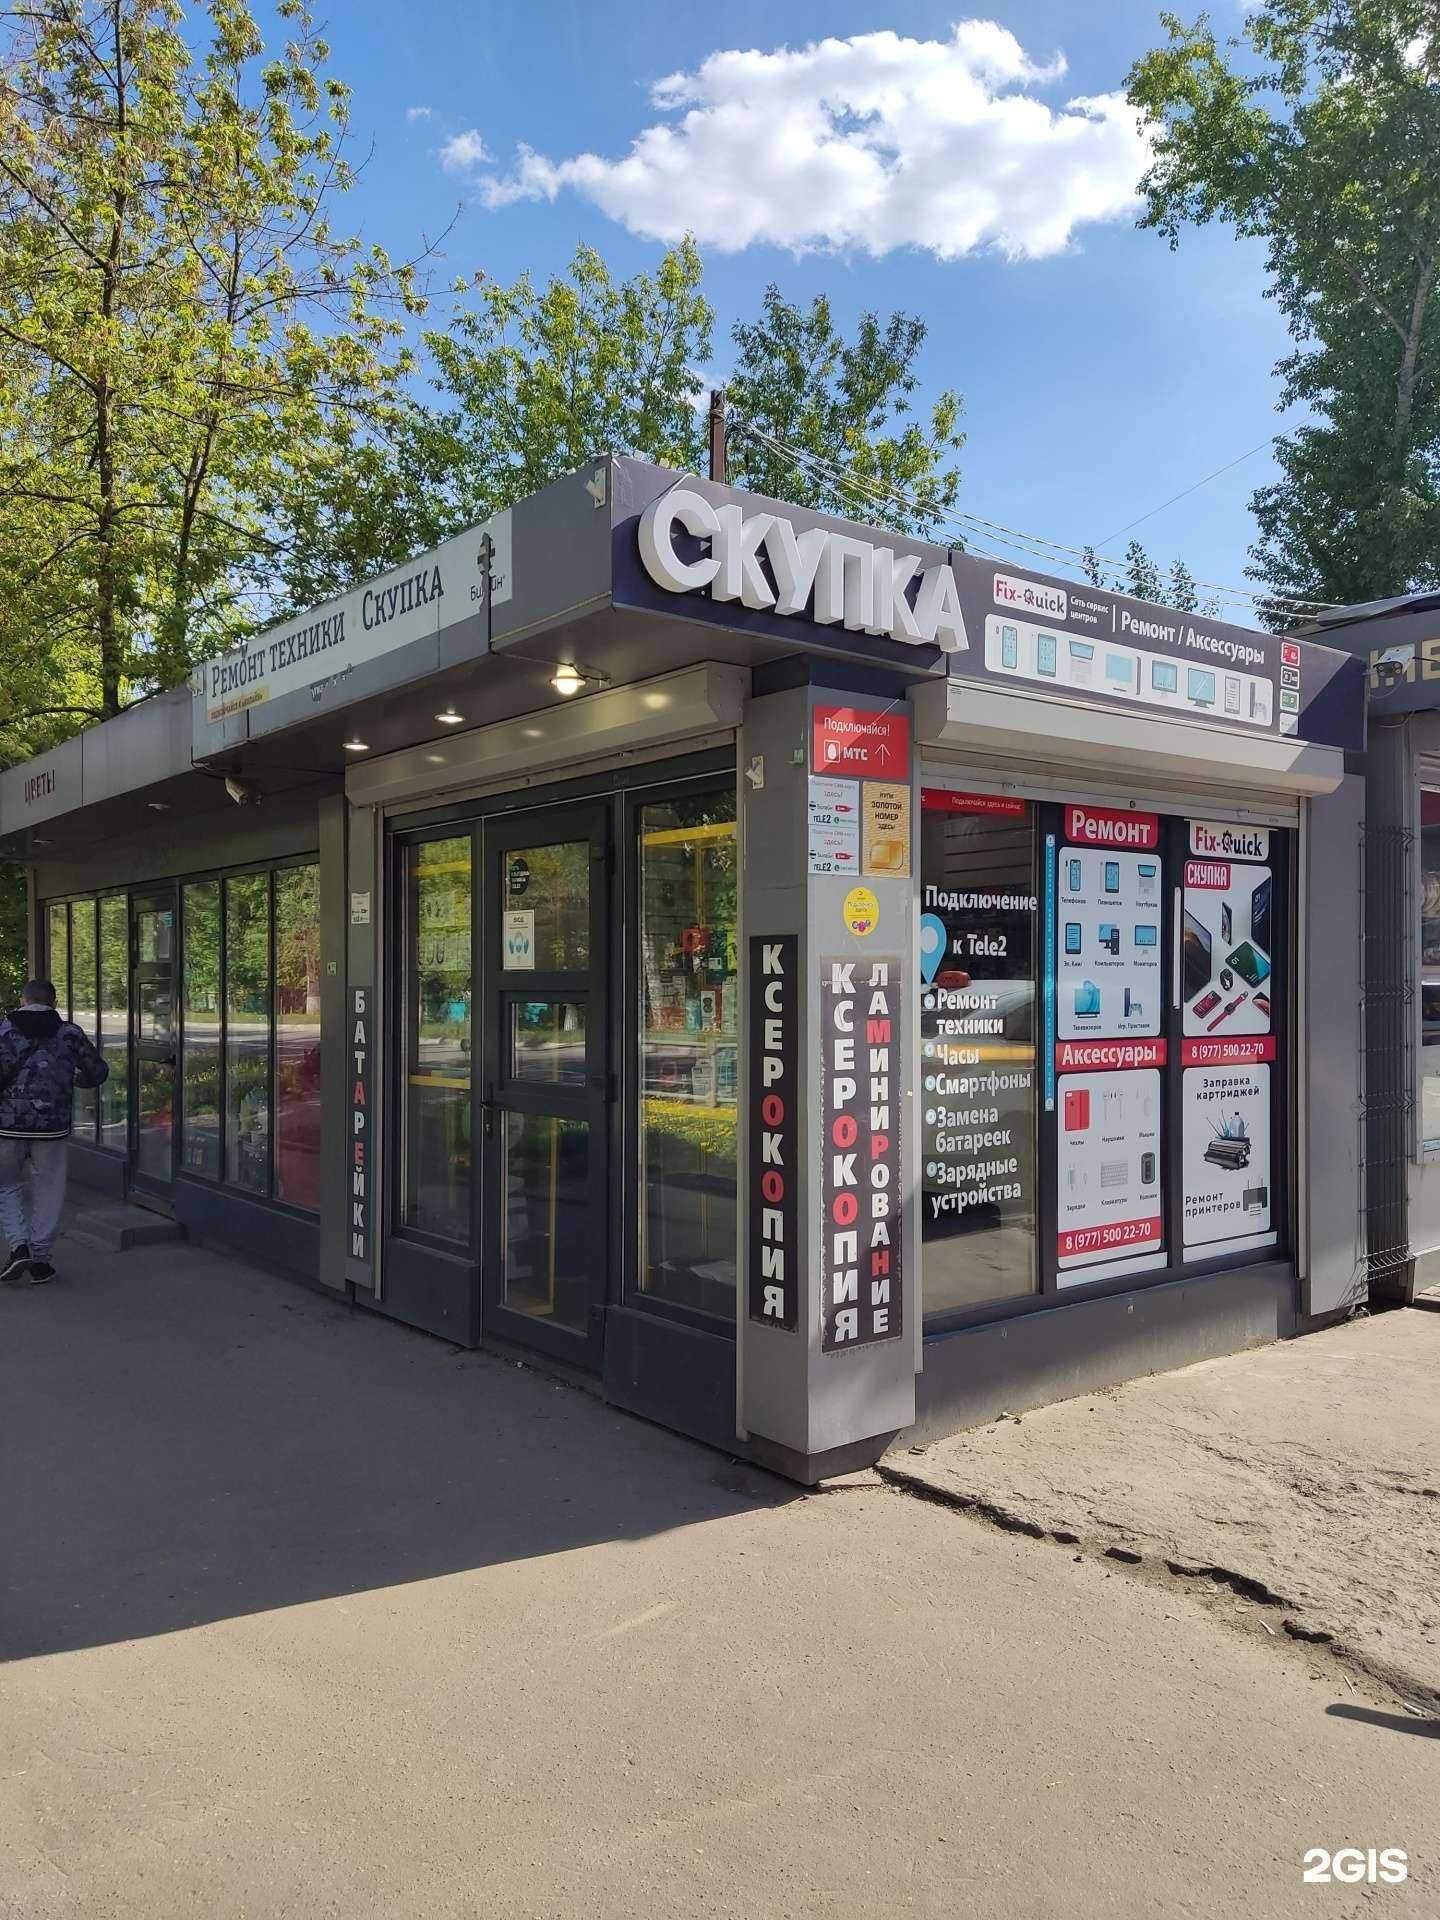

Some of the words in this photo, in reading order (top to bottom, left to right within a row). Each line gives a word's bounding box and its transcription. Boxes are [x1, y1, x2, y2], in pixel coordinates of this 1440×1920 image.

[638, 490, 969, 652] СКУПКА
[995, 579, 1065, 614] Fix-Quick
[1070, 595, 1086, 608] Сеть
[1086, 599, 1109, 614] сервис
[1070, 610, 1098, 624] центров
[1121, 611, 1175, 643] Ремонт
[1186, 629, 1265, 665] Аксессуары
[824, 717, 890, 737] Подключайся!
[843, 746, 868, 761] МТС
[24, 769, 55, 806] ЦВЕТЫ
[871, 800, 902, 810] ЗОЛОТОЙ
[874, 812, 899, 821] НОМЕР
[1072, 809, 1151, 844] Ремонт
[1195, 826, 1263, 856] Fix-Quick
[1187, 864, 1227, 887] СКУПКА
[926, 885, 1038, 911] Подключение
[967, 934, 1007, 957] Tele2
[936, 988, 999, 1010] Ремонт
[936, 1018, 1004, 1035] техники
[936, 1043, 980, 1066] Часы
[1062, 1043, 1157, 1068] Аксессуары
[1191, 1047, 1198, 1058] 8
[1199, 1045, 1222, 1060] (977)
[1223, 1044, 1239, 1056] 500
[1241, 1043, 1264, 1056] 22-70
[936, 1071, 1031, 1097] Смартфоны
[1196, 1086, 1260, 1101] картриджей
[1203, 1076, 1250, 1089] Заправка
[352, 990, 366, 1258] БАТАРЕЙКИ
[937, 1106, 999, 1129] Замена
[762, 943, 785, 1320] КСЕРОКОПИЯ
[935, 1129, 1011, 1154] батареек
[832, 962, 858, 1343] КСЕРОКОПИЯ
[867, 962, 891, 1335] ЛАМИНИРОВАНИЕ
[937, 1157, 1018, 1187] Зарядные
[931, 1182, 1022, 1218] устройства
[1185, 1192, 1224, 1205] Ремонт
[1185, 1201, 1241, 1217] принтеров
[1066, 1237, 1072, 1250] 8
[1075, 1231, 1101, 1248] (977)
[1103, 1228, 1122, 1243] 500
[1123, 1222, 1151, 1240] 22-70
